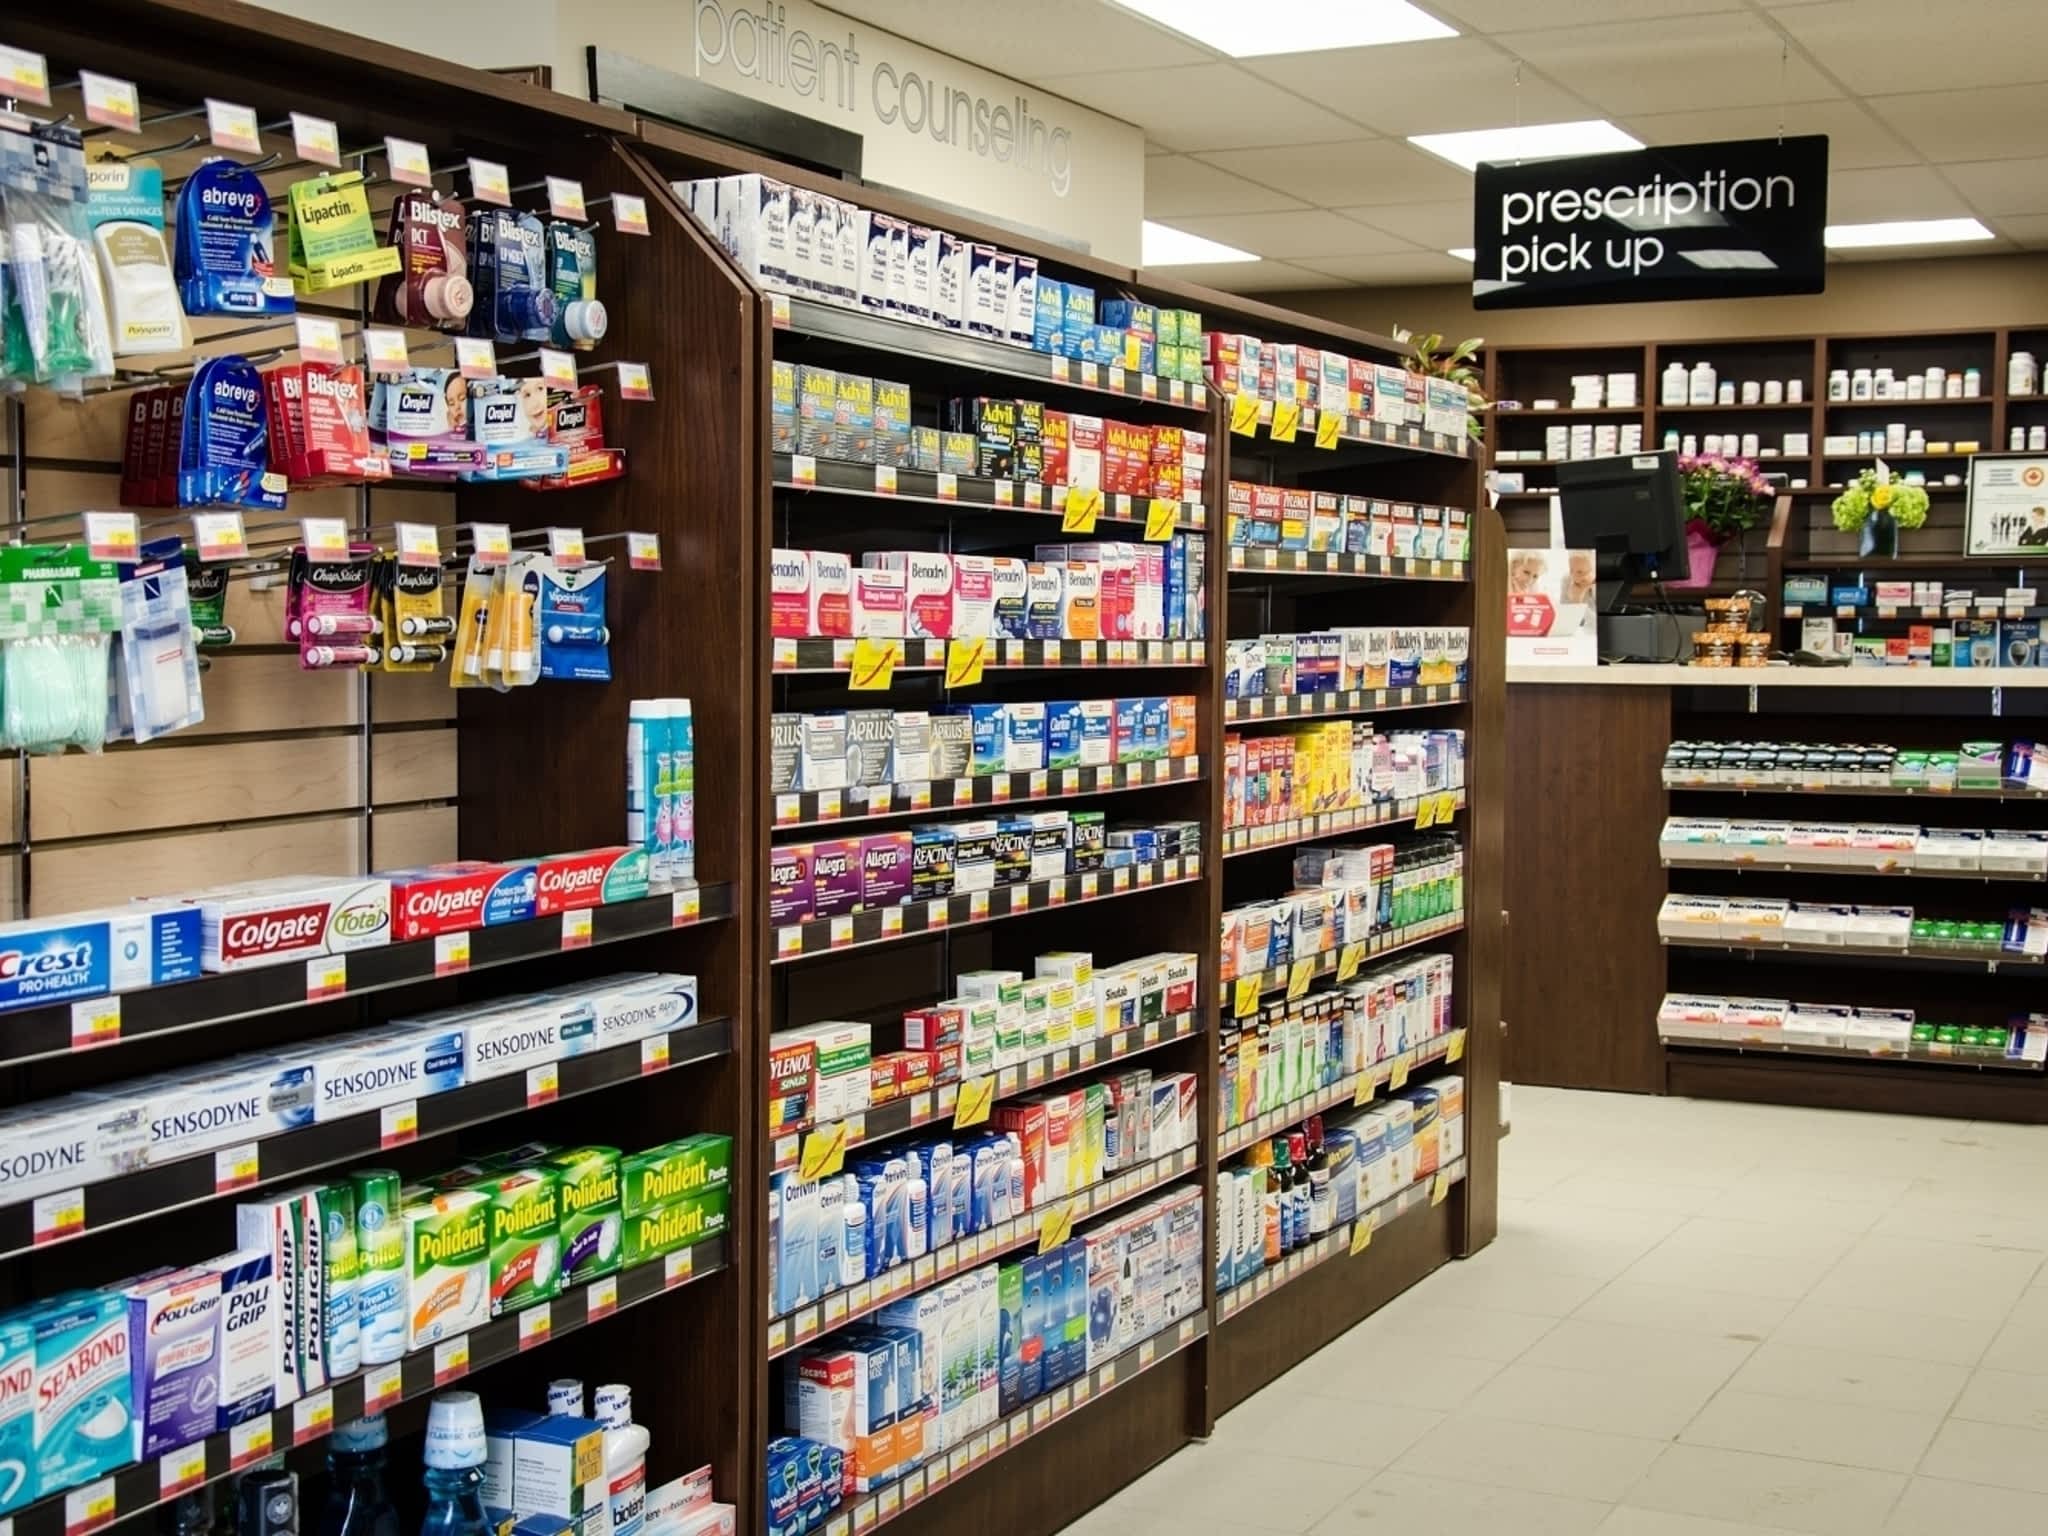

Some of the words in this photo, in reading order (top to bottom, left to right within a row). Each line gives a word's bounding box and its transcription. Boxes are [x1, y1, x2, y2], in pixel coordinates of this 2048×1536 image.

[692, 0, 860, 111] patient
[872, 62, 1072, 197] counseling
[202, 187, 255, 207] abreva
[1502, 169, 1795, 235] prescription
[302, 200, 352, 224] Lipactin
[411, 201, 461, 232] Blistex
[411, 228, 428, 245] DCT
[499, 218, 540, 247] Blistex
[555, 231, 592, 258] Blistex
[1502, 233, 1592, 282] pick
[1605, 237, 1664, 276] up
[331, 263, 364, 279] Lipactin
[1066, 293, 1094, 313] Advil
[214, 380, 255, 403] abreva
[307, 371, 358, 402] Blistex
[805, 373, 834, 394] Advil
[838, 379, 871, 401] Advil
[402, 393, 433, 411] Orajel
[878, 386, 908, 408] Advil
[487, 404, 514, 423] Orajel
[558, 407, 585, 427] Orajel
[983, 403, 1013, 425] Advil
[22, 566, 82, 579] PHARMASAVE
[313, 565, 365, 584] ChapStick
[398, 571, 435, 588] ChapStick
[771, 560, 804, 583] enadryl
[817, 561, 847, 583] Benadryl
[911, 563, 948, 584] Benadryl
[994, 568, 1024, 589] Benadryl
[1069, 571, 1095, 590] Benadryl
[1031, 576, 1057, 591] Benadryl
[1854, 645, 1873, 654] Nix
[773, 724, 802, 745] RIUS
[814, 857, 846, 877] Allegra
[865, 849, 897, 870] Allegra
[913, 846, 954, 866] REACTINE
[540, 867, 603, 893] Colgate
[407, 887, 483, 917] Colgate
[338, 909, 381, 931] Total
[227, 918, 320, 949] Colgate
[0, 943, 91, 980] Crest
[1168, 966, 1187, 980] Sinutab
[1106, 985, 1128, 1000] Sinutab
[602, 1004, 656, 1032] SENSODYNE
[476, 1026, 555, 1062] SENSODYNE
[324, 1061, 418, 1100] SENSODYNE
[780, 1075, 807, 1091] SINUS
[151, 1097, 261, 1142] SENSODYNE
[643, 1159, 706, 1202] Polident
[786, 1181, 816, 1202] Otrivin
[562, 1172, 618, 1213] Polident
[821, 1191, 842, 1208] Otrivin
[494, 1196, 556, 1237] Polident
[640, 1204, 703, 1251] Polident
[418, 1218, 485, 1264] Polident
[229, 1286, 269, 1314] POLI
[308, 1218, 320, 1361] POLIGRIP
[283, 1229, 294, 1374] POLIGRIP
[226, 1304, 266, 1332] GRIP
